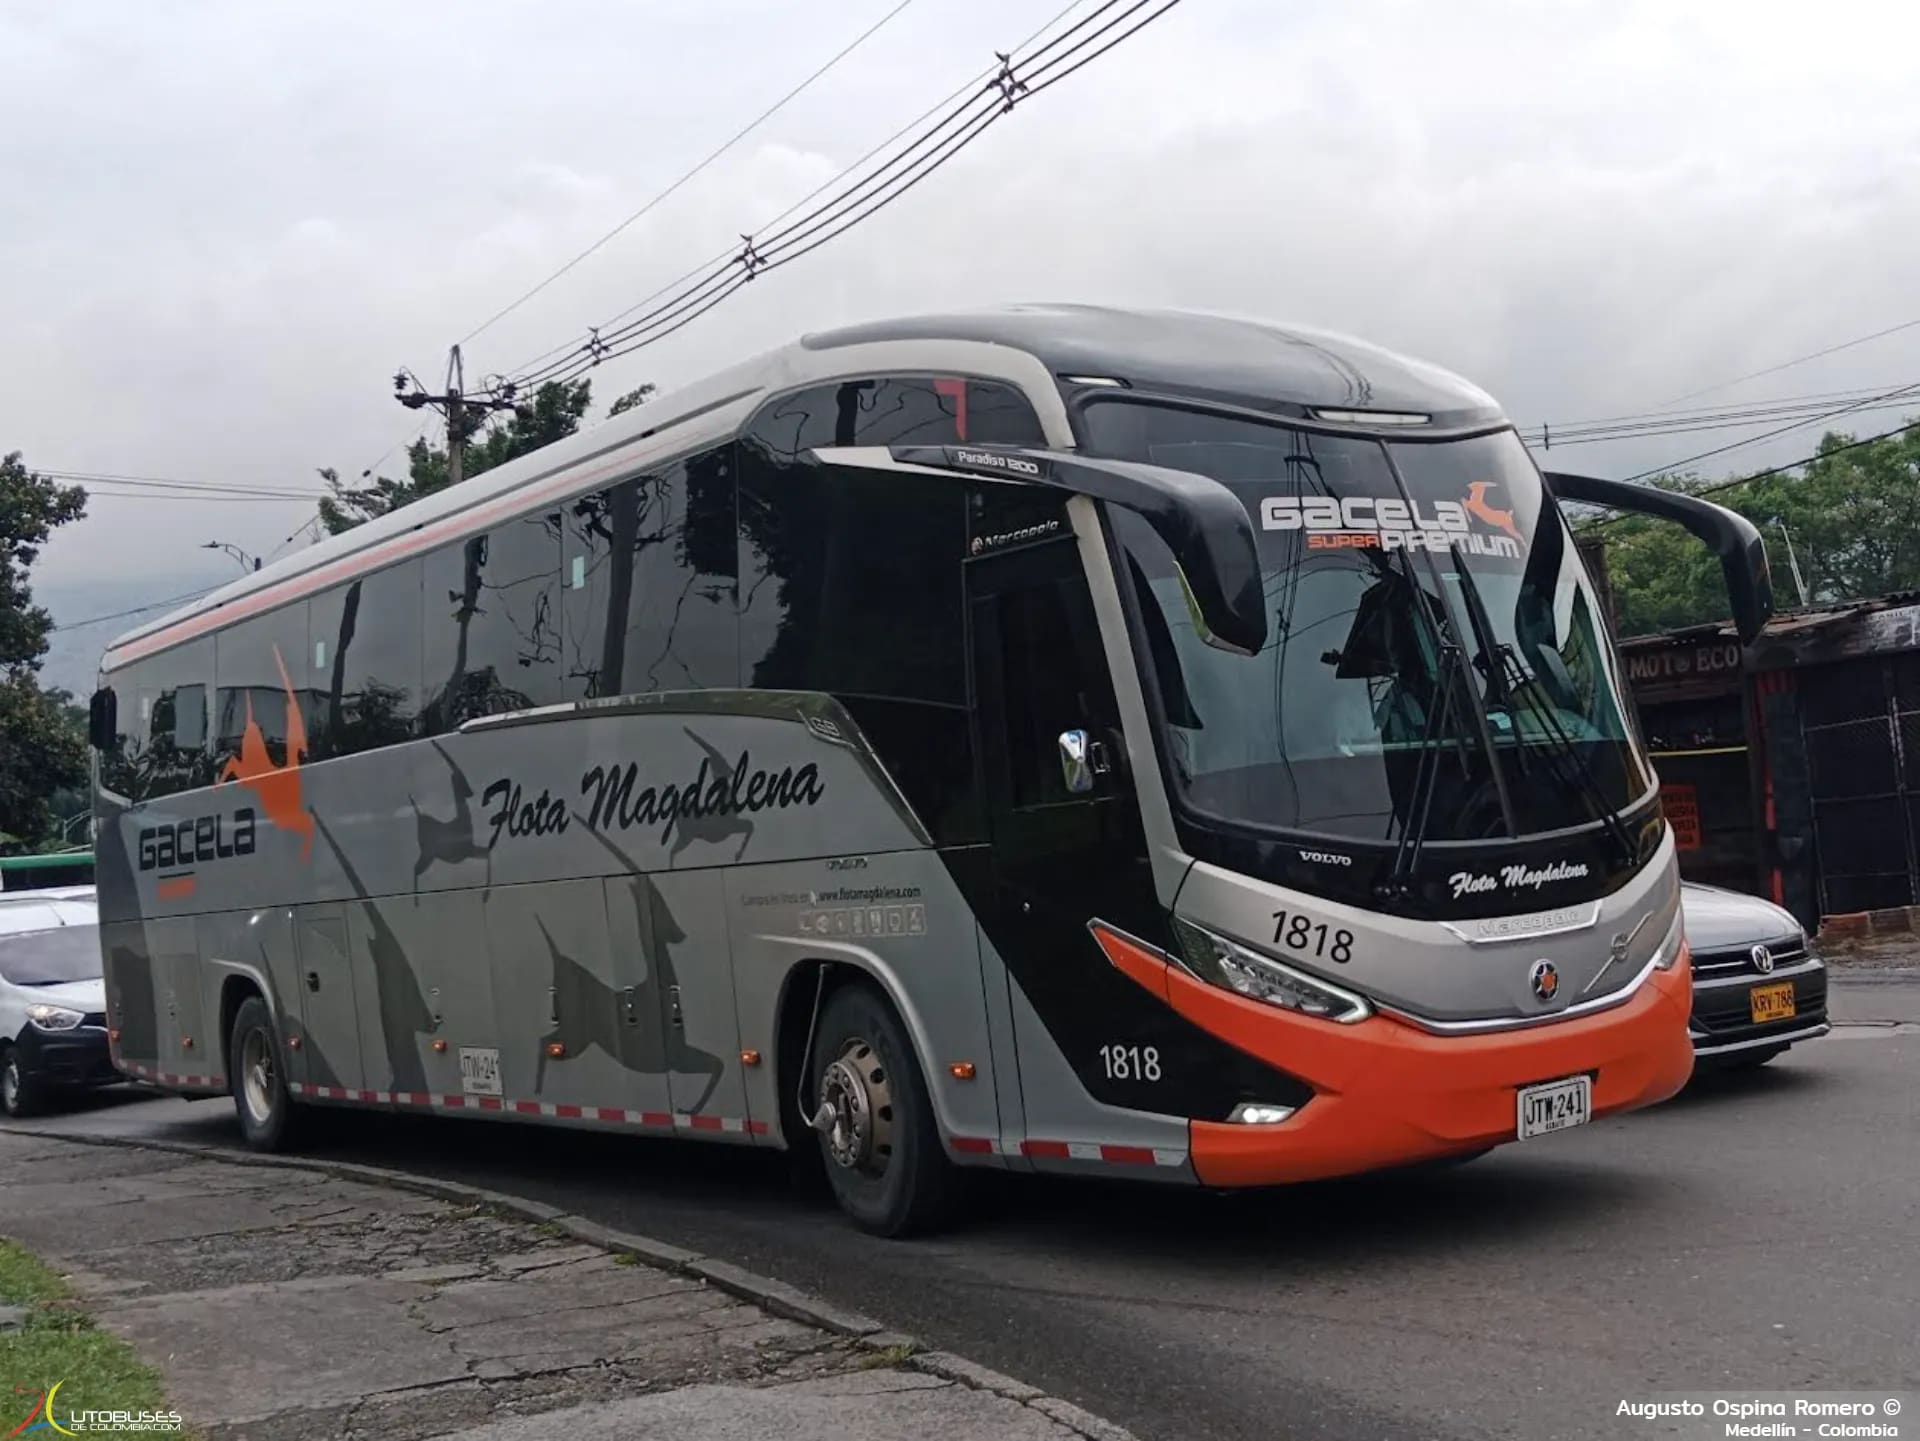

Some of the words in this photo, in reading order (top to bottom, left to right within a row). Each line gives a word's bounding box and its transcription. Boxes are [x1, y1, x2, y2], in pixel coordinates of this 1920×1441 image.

[958, 450, 1006, 467] Paradiso
[1007, 458, 1039, 474] 1200
[482, 777, 570, 851] Flota
[582, 750, 825, 846] Magdalena
[1300, 851, 1352, 866] VOLVO
[1449, 871, 1498, 899] Flota
[1501, 861, 1589, 890] Magdalena
[1272, 911, 1354, 964] 1818
[1100, 1045, 1161, 1081] 1818
